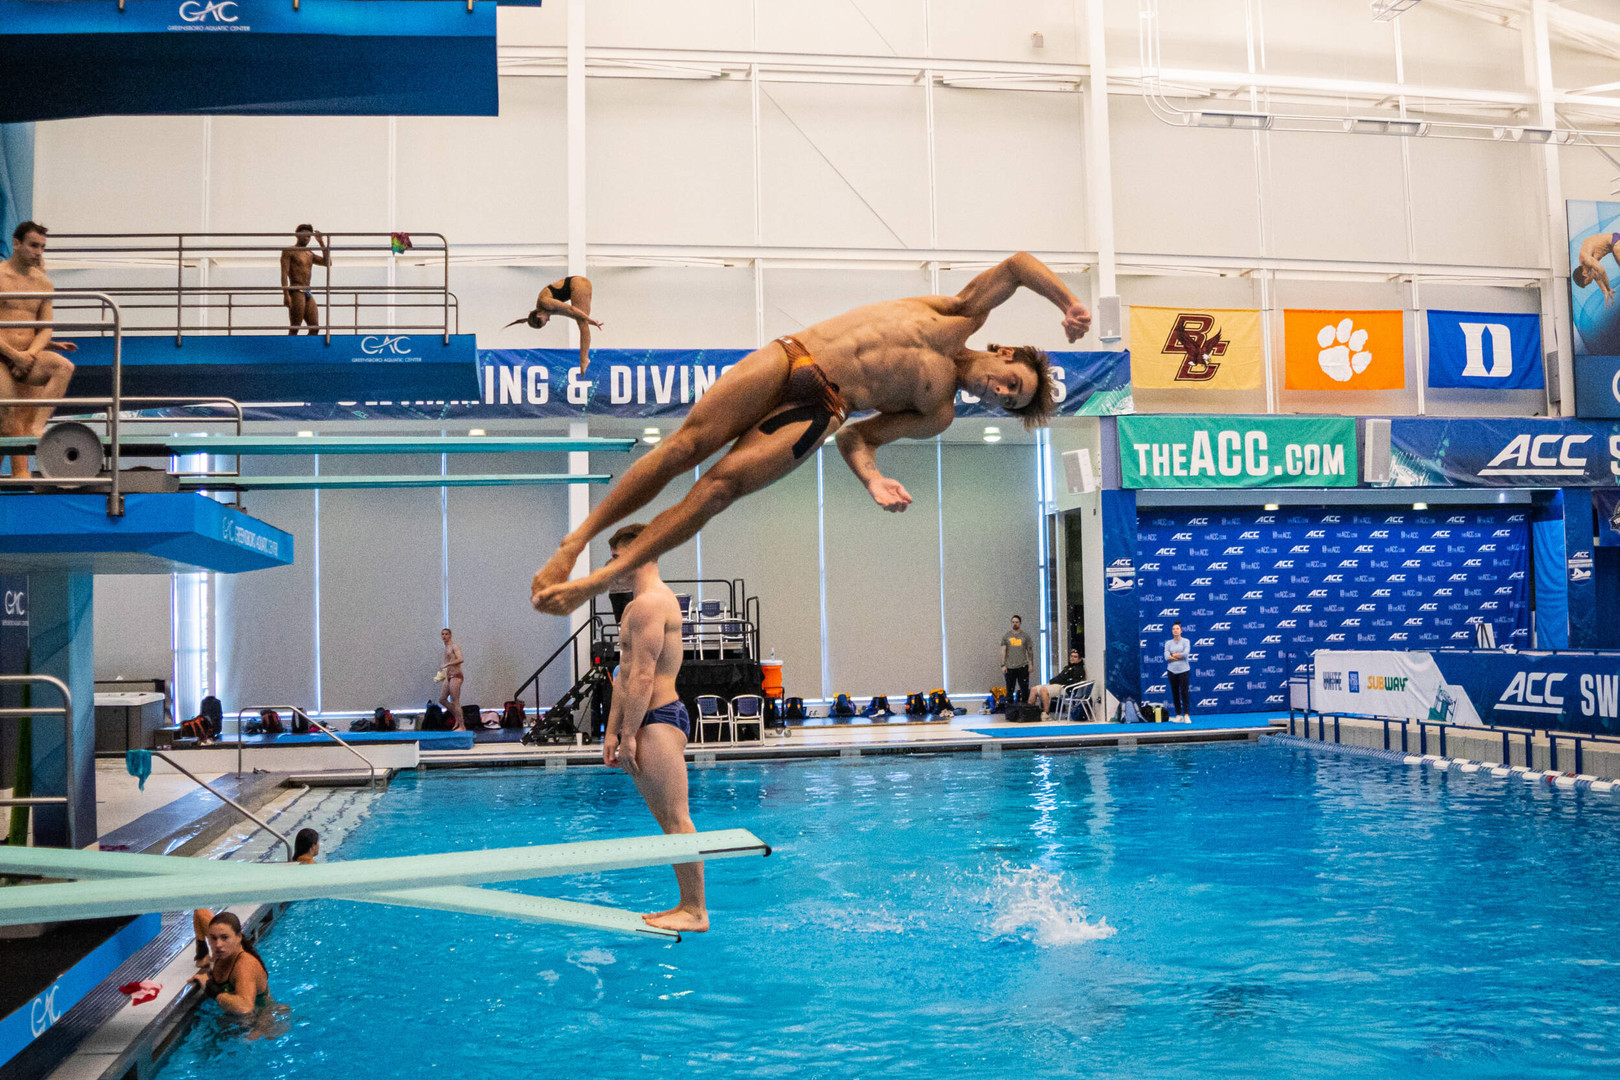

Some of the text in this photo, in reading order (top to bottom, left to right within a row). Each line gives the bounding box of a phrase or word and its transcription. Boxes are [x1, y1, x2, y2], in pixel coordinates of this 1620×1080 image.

[179, 1, 239, 21] GAC
[361, 335, 412, 355] GAC
[1161, 313, 1230, 381] BC
[1458, 322, 1513, 378] D
[567, 366, 593, 404] &
[610, 365, 736, 404] DIVIN
[1134, 430, 1345, 477] THEACC.COM
[1477, 434, 1593, 476] ACC
[1187, 518, 1208, 526] ACC
[1255, 516, 1275, 524] ACC
[1321, 515, 1341, 523] ACC
[1384, 516, 1404, 524] ACC
[1446, 516, 1465, 524] ACC
[1170, 533, 1193, 541] ACC
[1238, 531, 1260, 539] ACC
[1304, 530, 1326, 538] ACC
[1368, 530, 1389, 538] ACC
[1431, 530, 1451, 538] ACC
[1491, 529, 1511, 537] ACC
[1154, 548, 1176, 556] ACC
[1222, 546, 1244, 554] ACC
[1288, 545, 1310, 553] ACC
[1353, 545, 1374, 553] ACC
[1416, 545, 1436, 553] ACC
[1477, 544, 1496, 552] ACC
[1139, 563, 1160, 571] ACC
[1206, 562, 1228, 570] ACC
[1273, 560, 1294, 568] ACC
[1337, 560, 1359, 568] ACC
[1401, 559, 1421, 567] ACC
[1462, 559, 1482, 567] ACC
[1190, 577, 1212, 585] ACC
[1257, 575, 1279, 583] ACC
[1322, 574, 1343, 582] ACC
[1386, 574, 1406, 582] ACC
[1448, 573, 1468, 581] ACC
[1307, 589, 1328, 597] ACC
[1370, 589, 1391, 597] ACC
[1433, 588, 1453, 596] ACC
[1494, 586, 1513, 594] ACC
[1174, 593, 1196, 601] ACC
[1241, 590, 1263, 599] ACC
[1291, 604, 1312, 612] ACC
[1355, 603, 1376, 611] ACC
[1418, 603, 1438, 611] ACC
[1479, 601, 1498, 609] ACC
[1157, 608, 1180, 616] ACC
[1225, 606, 1247, 614] ACC
[1275, 619, 1297, 627] ACC
[1340, 618, 1361, 626] ACC
[1403, 618, 1423, 626] ACC
[1465, 616, 1484, 624] ACC
[1142, 624, 1164, 632] ACC
[1209, 622, 1232, 630] ACC
[1324, 633, 1346, 641] ACC
[1388, 632, 1408, 640] ACC
[1450, 631, 1469, 639] ACC
[1510, 629, 1528, 637] ACC
[1194, 637, 1215, 646] ACC
[1260, 635, 1282, 643] ACC
[1244, 650, 1266, 659] ACC
[1228, 666, 1251, 675] ACC
[1212, 682, 1235, 691] ACC
[1367, 676, 1408, 691] SUBWAY
[1144, 685, 1166, 693] ACC
[1493, 671, 1568, 714] ACC
[1196, 698, 1218, 706] ACC
[1264, 695, 1284, 703] ACC
